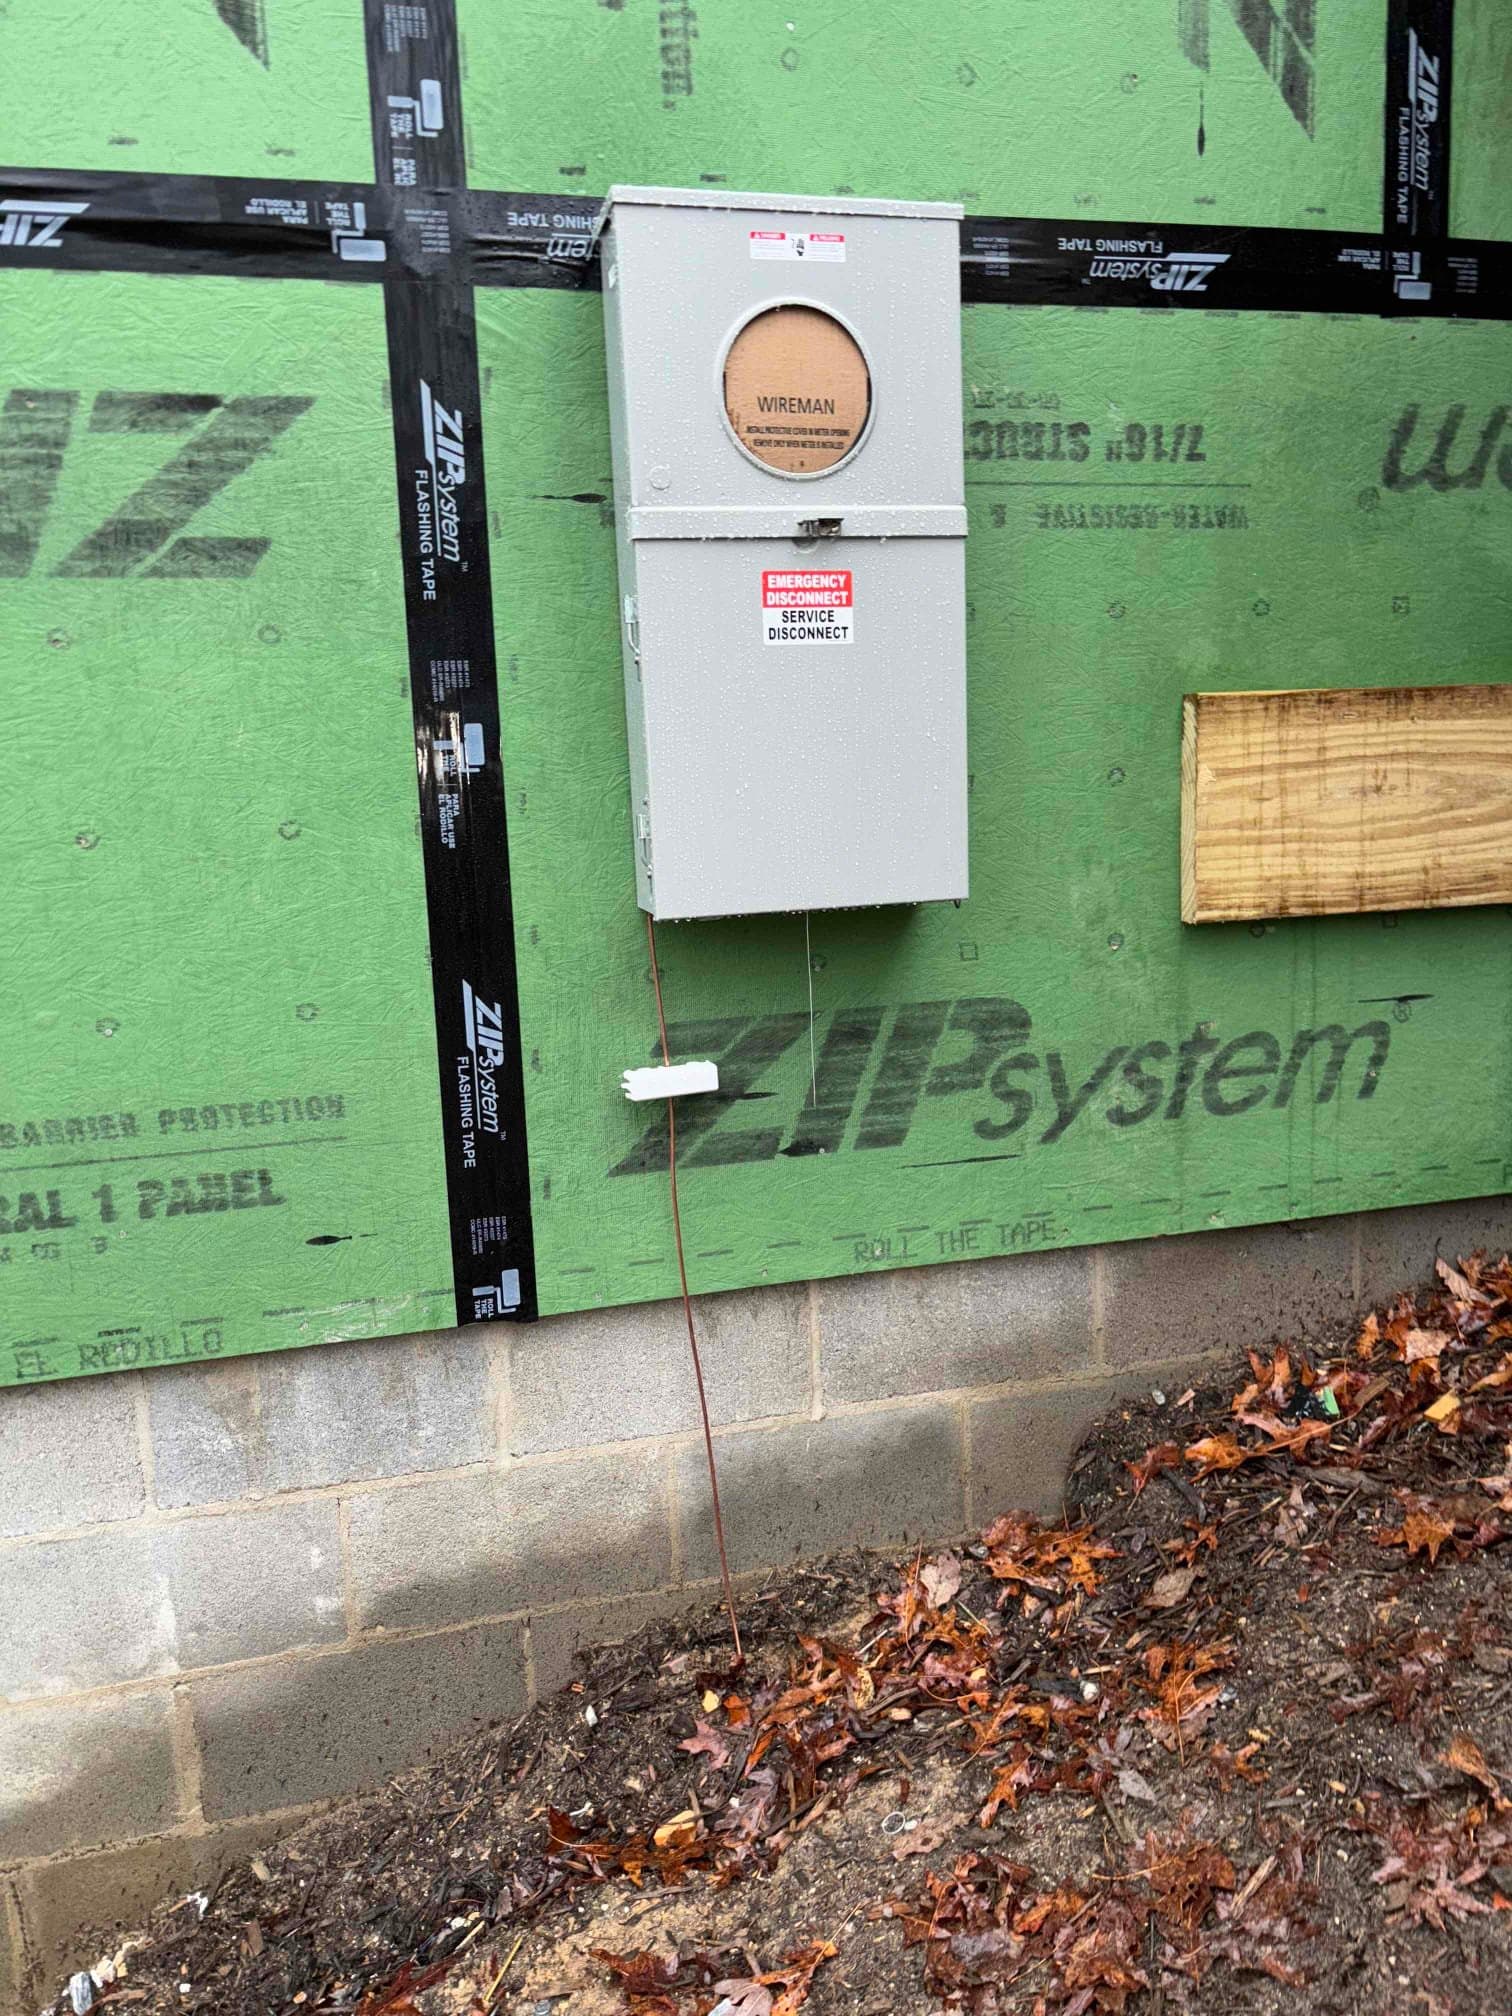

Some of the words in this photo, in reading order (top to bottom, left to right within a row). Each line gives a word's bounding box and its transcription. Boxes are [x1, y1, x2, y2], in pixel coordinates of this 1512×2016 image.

[389, 113, 398, 138] TAPE
[397, 113, 405, 133] THE
[405, 113, 413, 139] ROLL
[1397, 107, 1410, 182] FLASHING
[408, 159, 417, 185] PARA
[324, 201, 350, 210] TAPE
[331, 210, 350, 218] THE
[1396, 187, 1408, 224] TAPE
[282, 216, 309, 225] PARA
[326, 217, 351, 226] ROLL
[507, 212, 549, 227] TAPE
[1057, 237, 1091, 251] TAPE
[1096, 239, 1163, 254] FLASHING
[757, 396, 835, 415] WIREMAN
[415, 469, 433, 554] FLASHING
[420, 558, 436, 601] TAPE
[767, 574, 847, 589] EMERGENCY
[766, 591, 848, 605] DISCONNECT
[781, 610, 835, 623] SERVICE
[768, 626, 849, 640] DISCONNECT
[448, 754, 456, 776] ROLL
[438, 793, 446, 805] EL
[452, 793, 460, 816] PARA
[444, 793, 454, 829] APLICAR
[439, 806, 448, 844] RODILLO
[447, 830, 455, 848] USE
[457, 1056, 473, 1128] FLASHING
[157, 1094, 345, 1134] PROTECTION
[462, 1132, 476, 1168] TAPE
[92, 1183, 117, 1223] 1
[137, 1168, 287, 1220] PANEL
[854, 1235, 917, 1263] ROLL
[935, 1228, 979, 1254] THE
[997, 1219, 1056, 1248] TAPE
